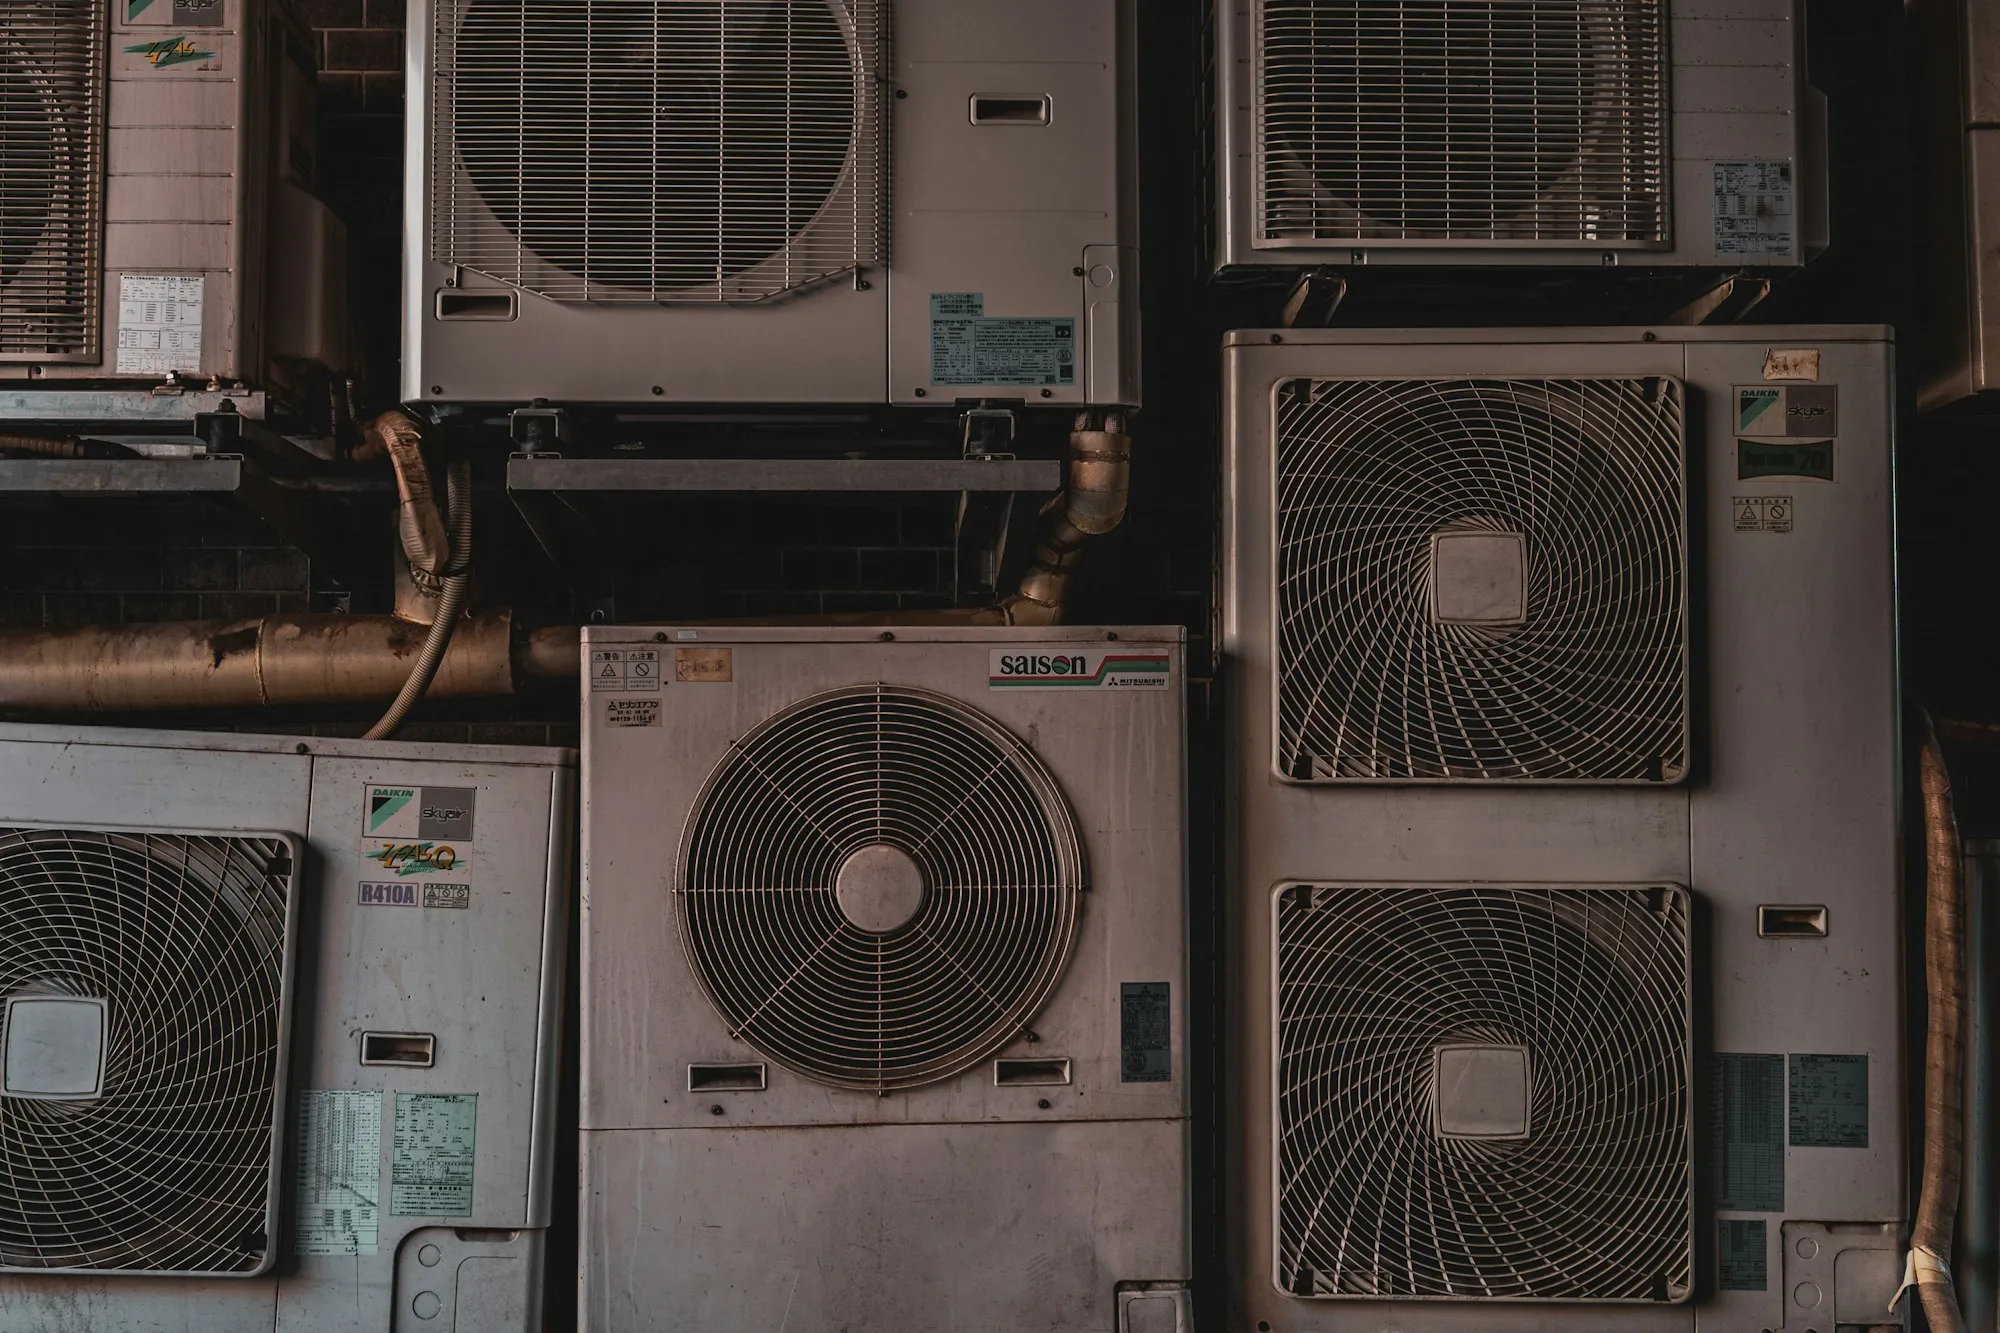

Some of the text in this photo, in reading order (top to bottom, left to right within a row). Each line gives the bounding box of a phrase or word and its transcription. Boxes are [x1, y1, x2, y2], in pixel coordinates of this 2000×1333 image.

[1788, 404, 1831, 420] skyair
[603, 652, 619, 661] 警告
[638, 652, 655, 661] 注意
[1000, 655, 1087, 675] saison
[618, 701, 659, 709] セゾンエアコン
[372, 788, 415, 798] DAIKIN
[422, 806, 468, 823] skyair
[361, 884, 415, 904] R410A
